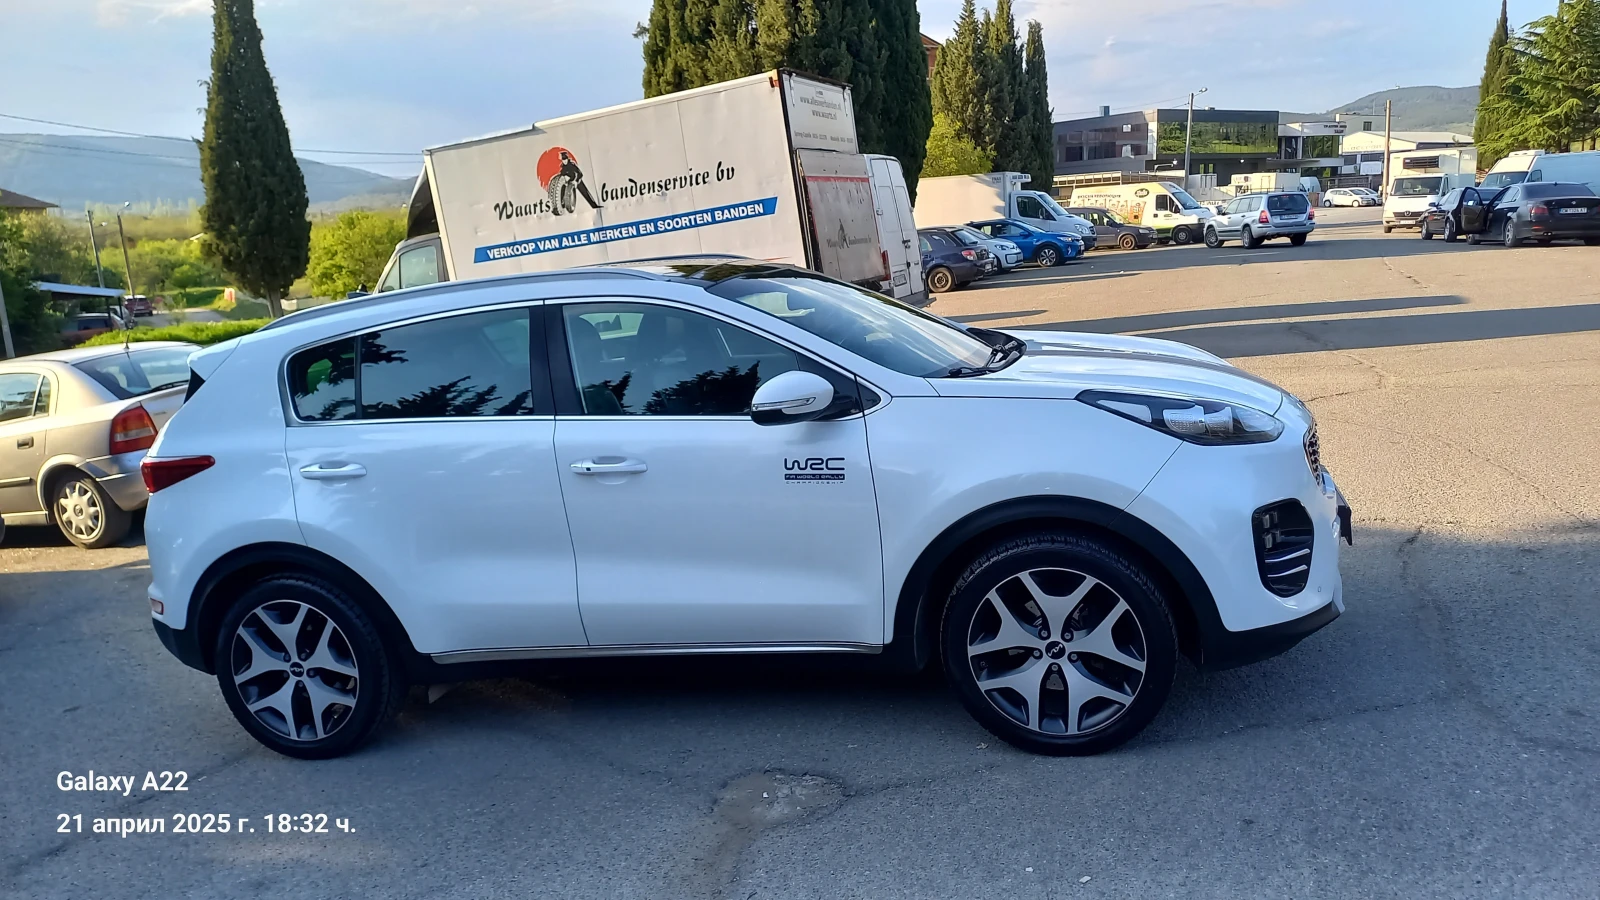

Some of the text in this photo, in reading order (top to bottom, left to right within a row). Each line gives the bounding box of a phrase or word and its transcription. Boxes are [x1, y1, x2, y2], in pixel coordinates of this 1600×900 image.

[494, 160, 735, 221] Waarts bandenservice bv
[487, 202, 765, 260] VERKOOP VAN ALLE MERKEN EN SOORTEN BANDEN
[784, 457, 845, 471] WRC
